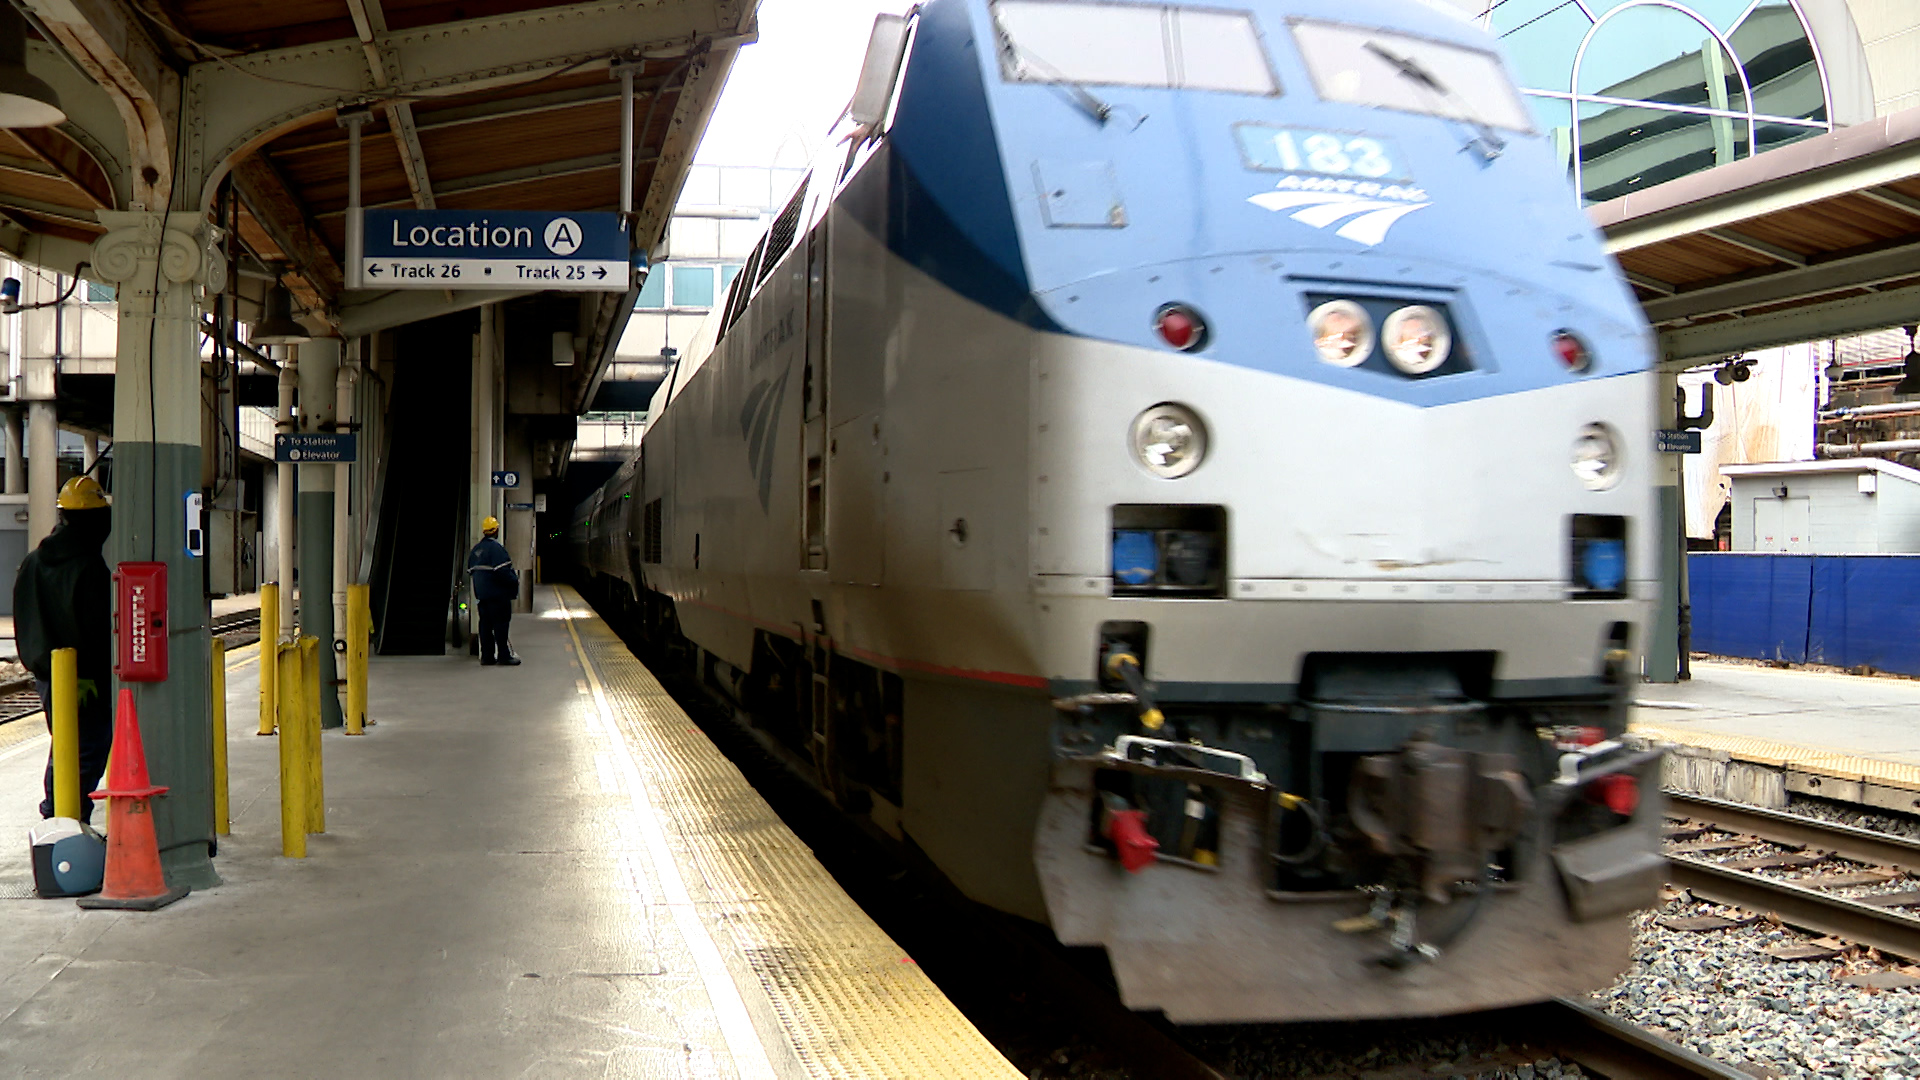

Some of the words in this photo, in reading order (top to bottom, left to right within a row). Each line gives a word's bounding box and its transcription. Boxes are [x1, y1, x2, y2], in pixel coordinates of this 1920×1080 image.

[1272, 131, 1392, 178] 183
[392, 219, 532, 248] Location
[391, 264, 434, 278] Track
[441, 264, 460, 278] 26
[516, 265, 559, 279] Track
[566, 266, 585, 280] 25
[291, 437, 301, 446] To
[303, 437, 337, 446] Station
[302, 450, 340, 460] Elevator
[132, 585, 145, 662] TELEPHONE
